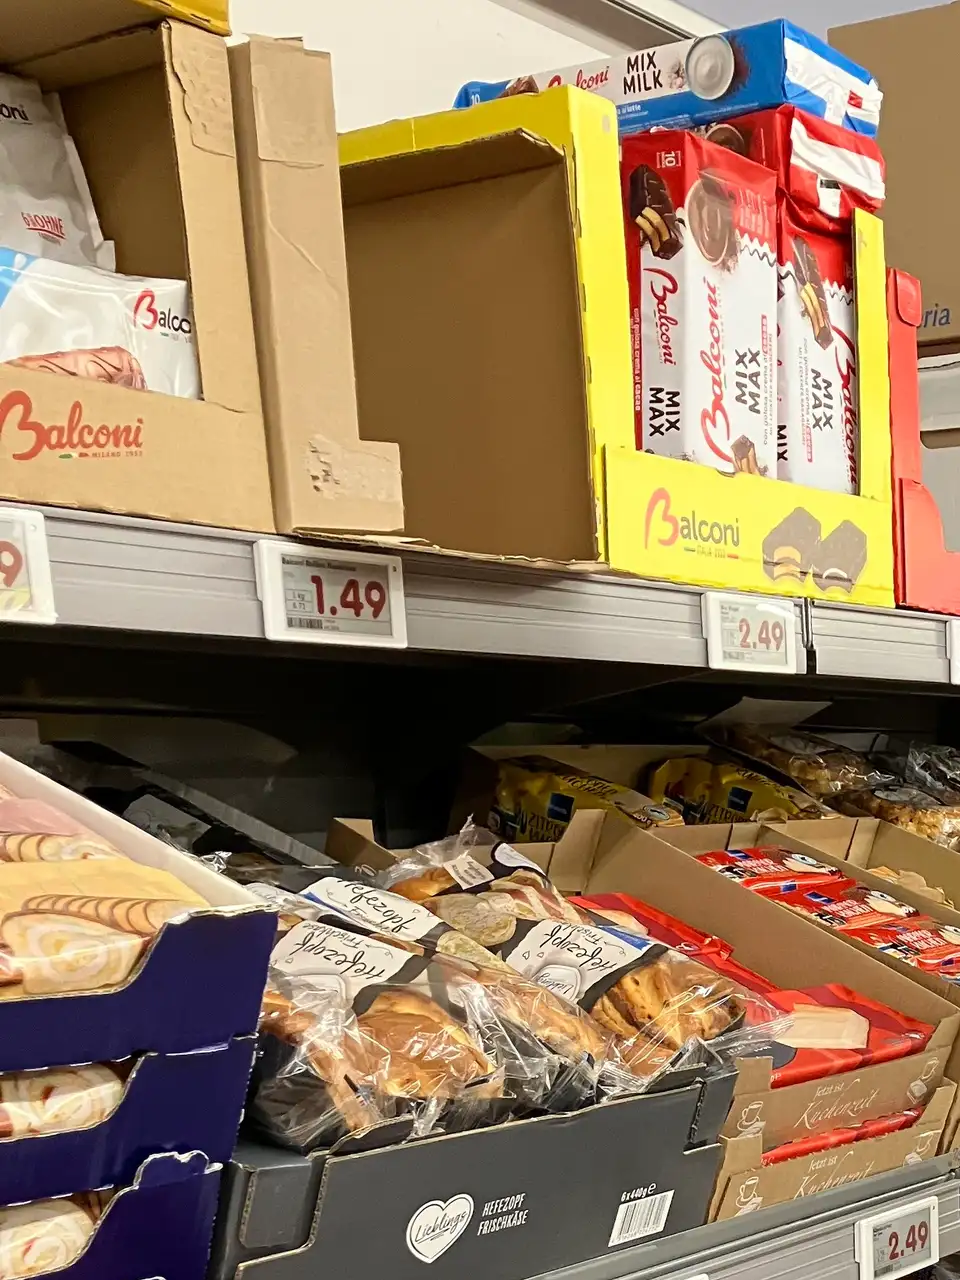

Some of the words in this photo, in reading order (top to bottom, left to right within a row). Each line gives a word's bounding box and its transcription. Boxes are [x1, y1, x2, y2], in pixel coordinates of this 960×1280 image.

[627, 51, 657, 70] MIX
[623, 71, 663, 95] MILK
[643, 267, 679, 366] Balconi
[921, 303, 951, 328] ria
[700, 276, 735, 464] Balconi
[735, 348, 749, 405] MIX
[749, 347, 761, 414] MAX
[649, 387, 665, 437] MAX
[665, 391, 681, 432] MIX
[811, 368, 823, 431] MAX
[822, 378, 833, 430] MIX
[0, 390, 144, 461] Balconi
[644, 487, 741, 550] Balconi
[311, 575, 386, 619] 1.49
[739, 618, 784, 651] 2.49
[289, 932, 386, 980] Hefezopf
[538, 924, 618, 973] Hefezopf
[794, 1084, 881, 1129] Kuchenzeit
[814, 1084, 830, 1098] Jetzt
[831, 1081, 845, 1092] ist
[808, 1159, 823, 1171] Jetzt
[824, 1155, 838, 1166] ist
[414, 1210, 468, 1240] Lieblings
[477, 1209, 529, 1236] FRISCHKÄSE
[482, 1192, 527, 1217] HEFEZOPF
[888, 1220, 929, 1261] 2.49
